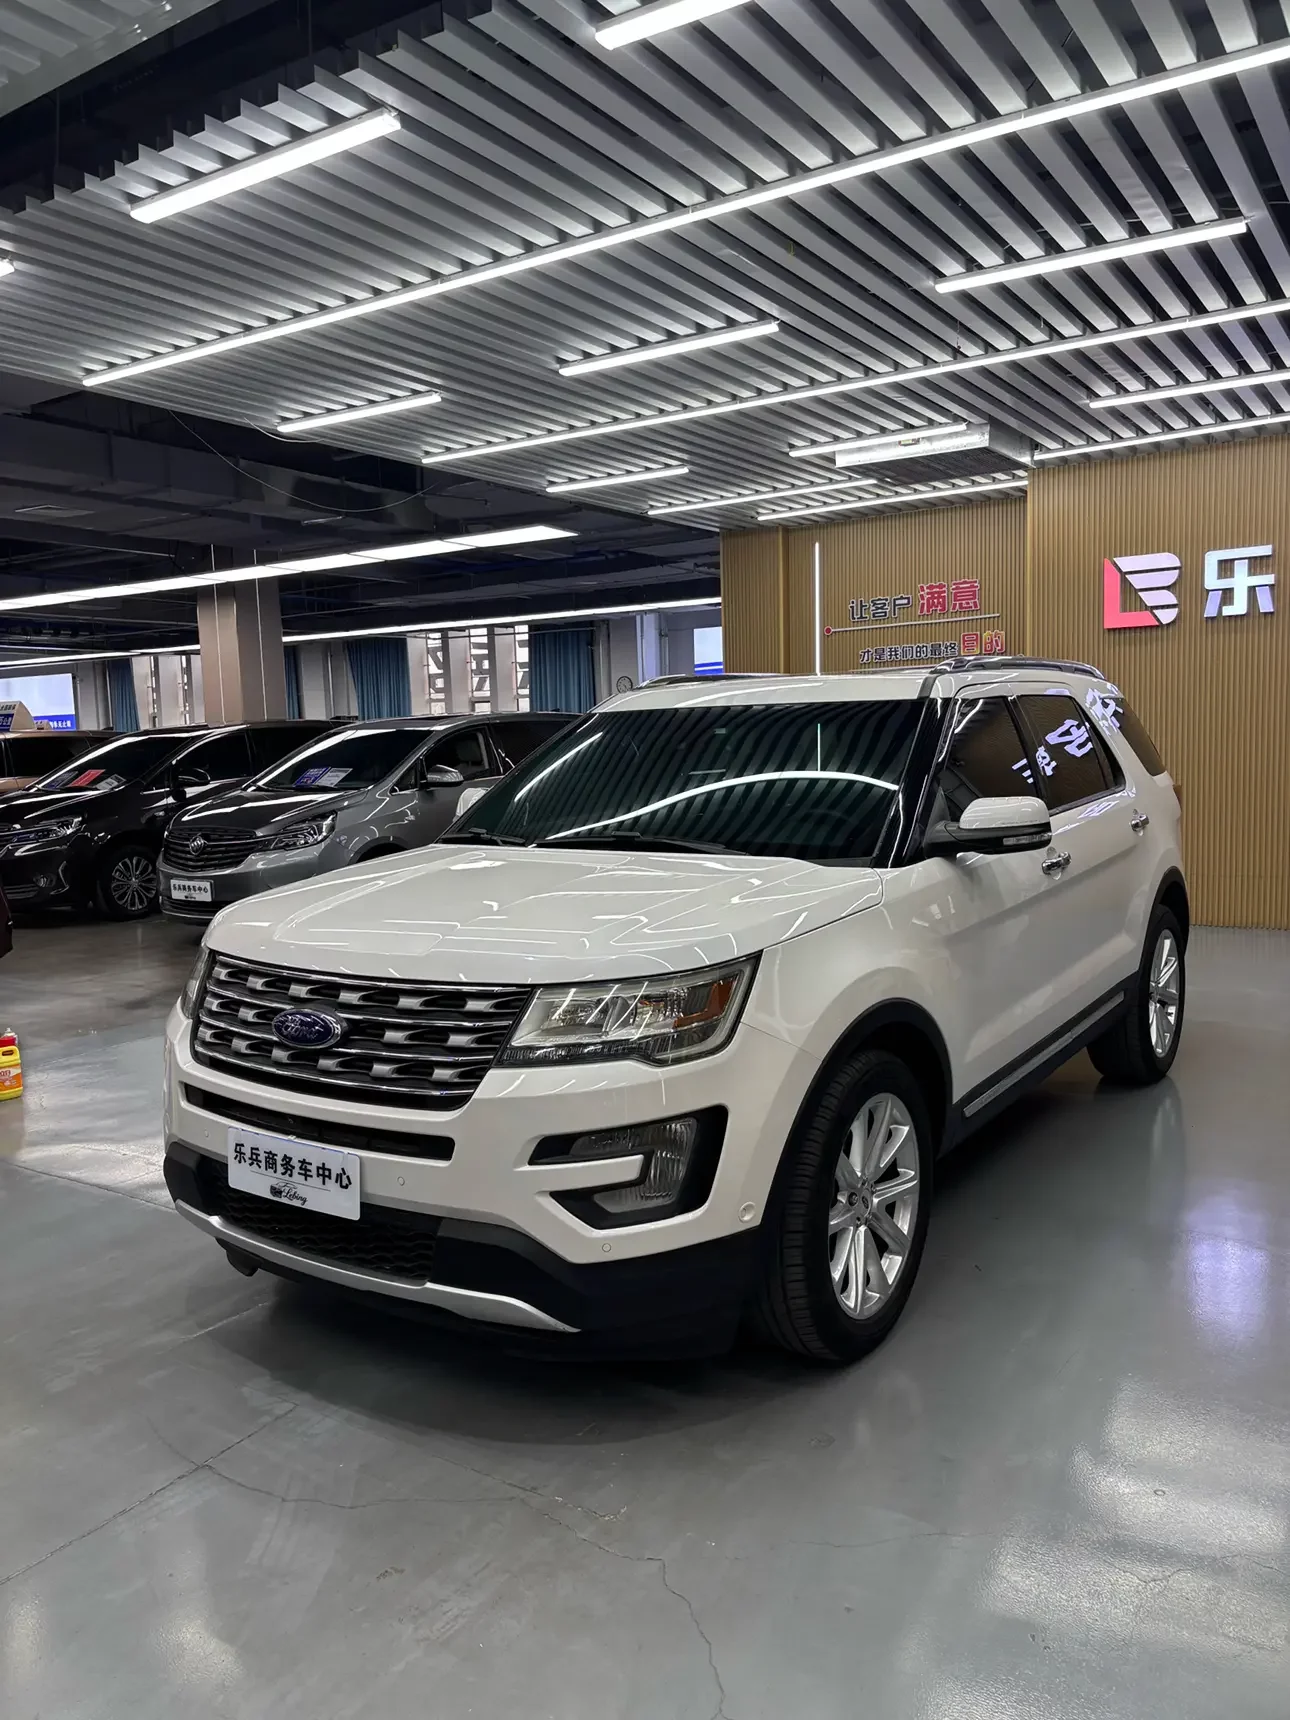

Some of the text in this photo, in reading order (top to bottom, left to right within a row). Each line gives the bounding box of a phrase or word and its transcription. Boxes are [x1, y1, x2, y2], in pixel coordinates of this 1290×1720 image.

[1203, 544, 1276, 618] 乐
[859, 629, 1006, 664] 才是我们的最终目的
[233, 1142, 353, 1190] 乐兵商务车中心
[282, 1186, 309, 1206] Lebing
